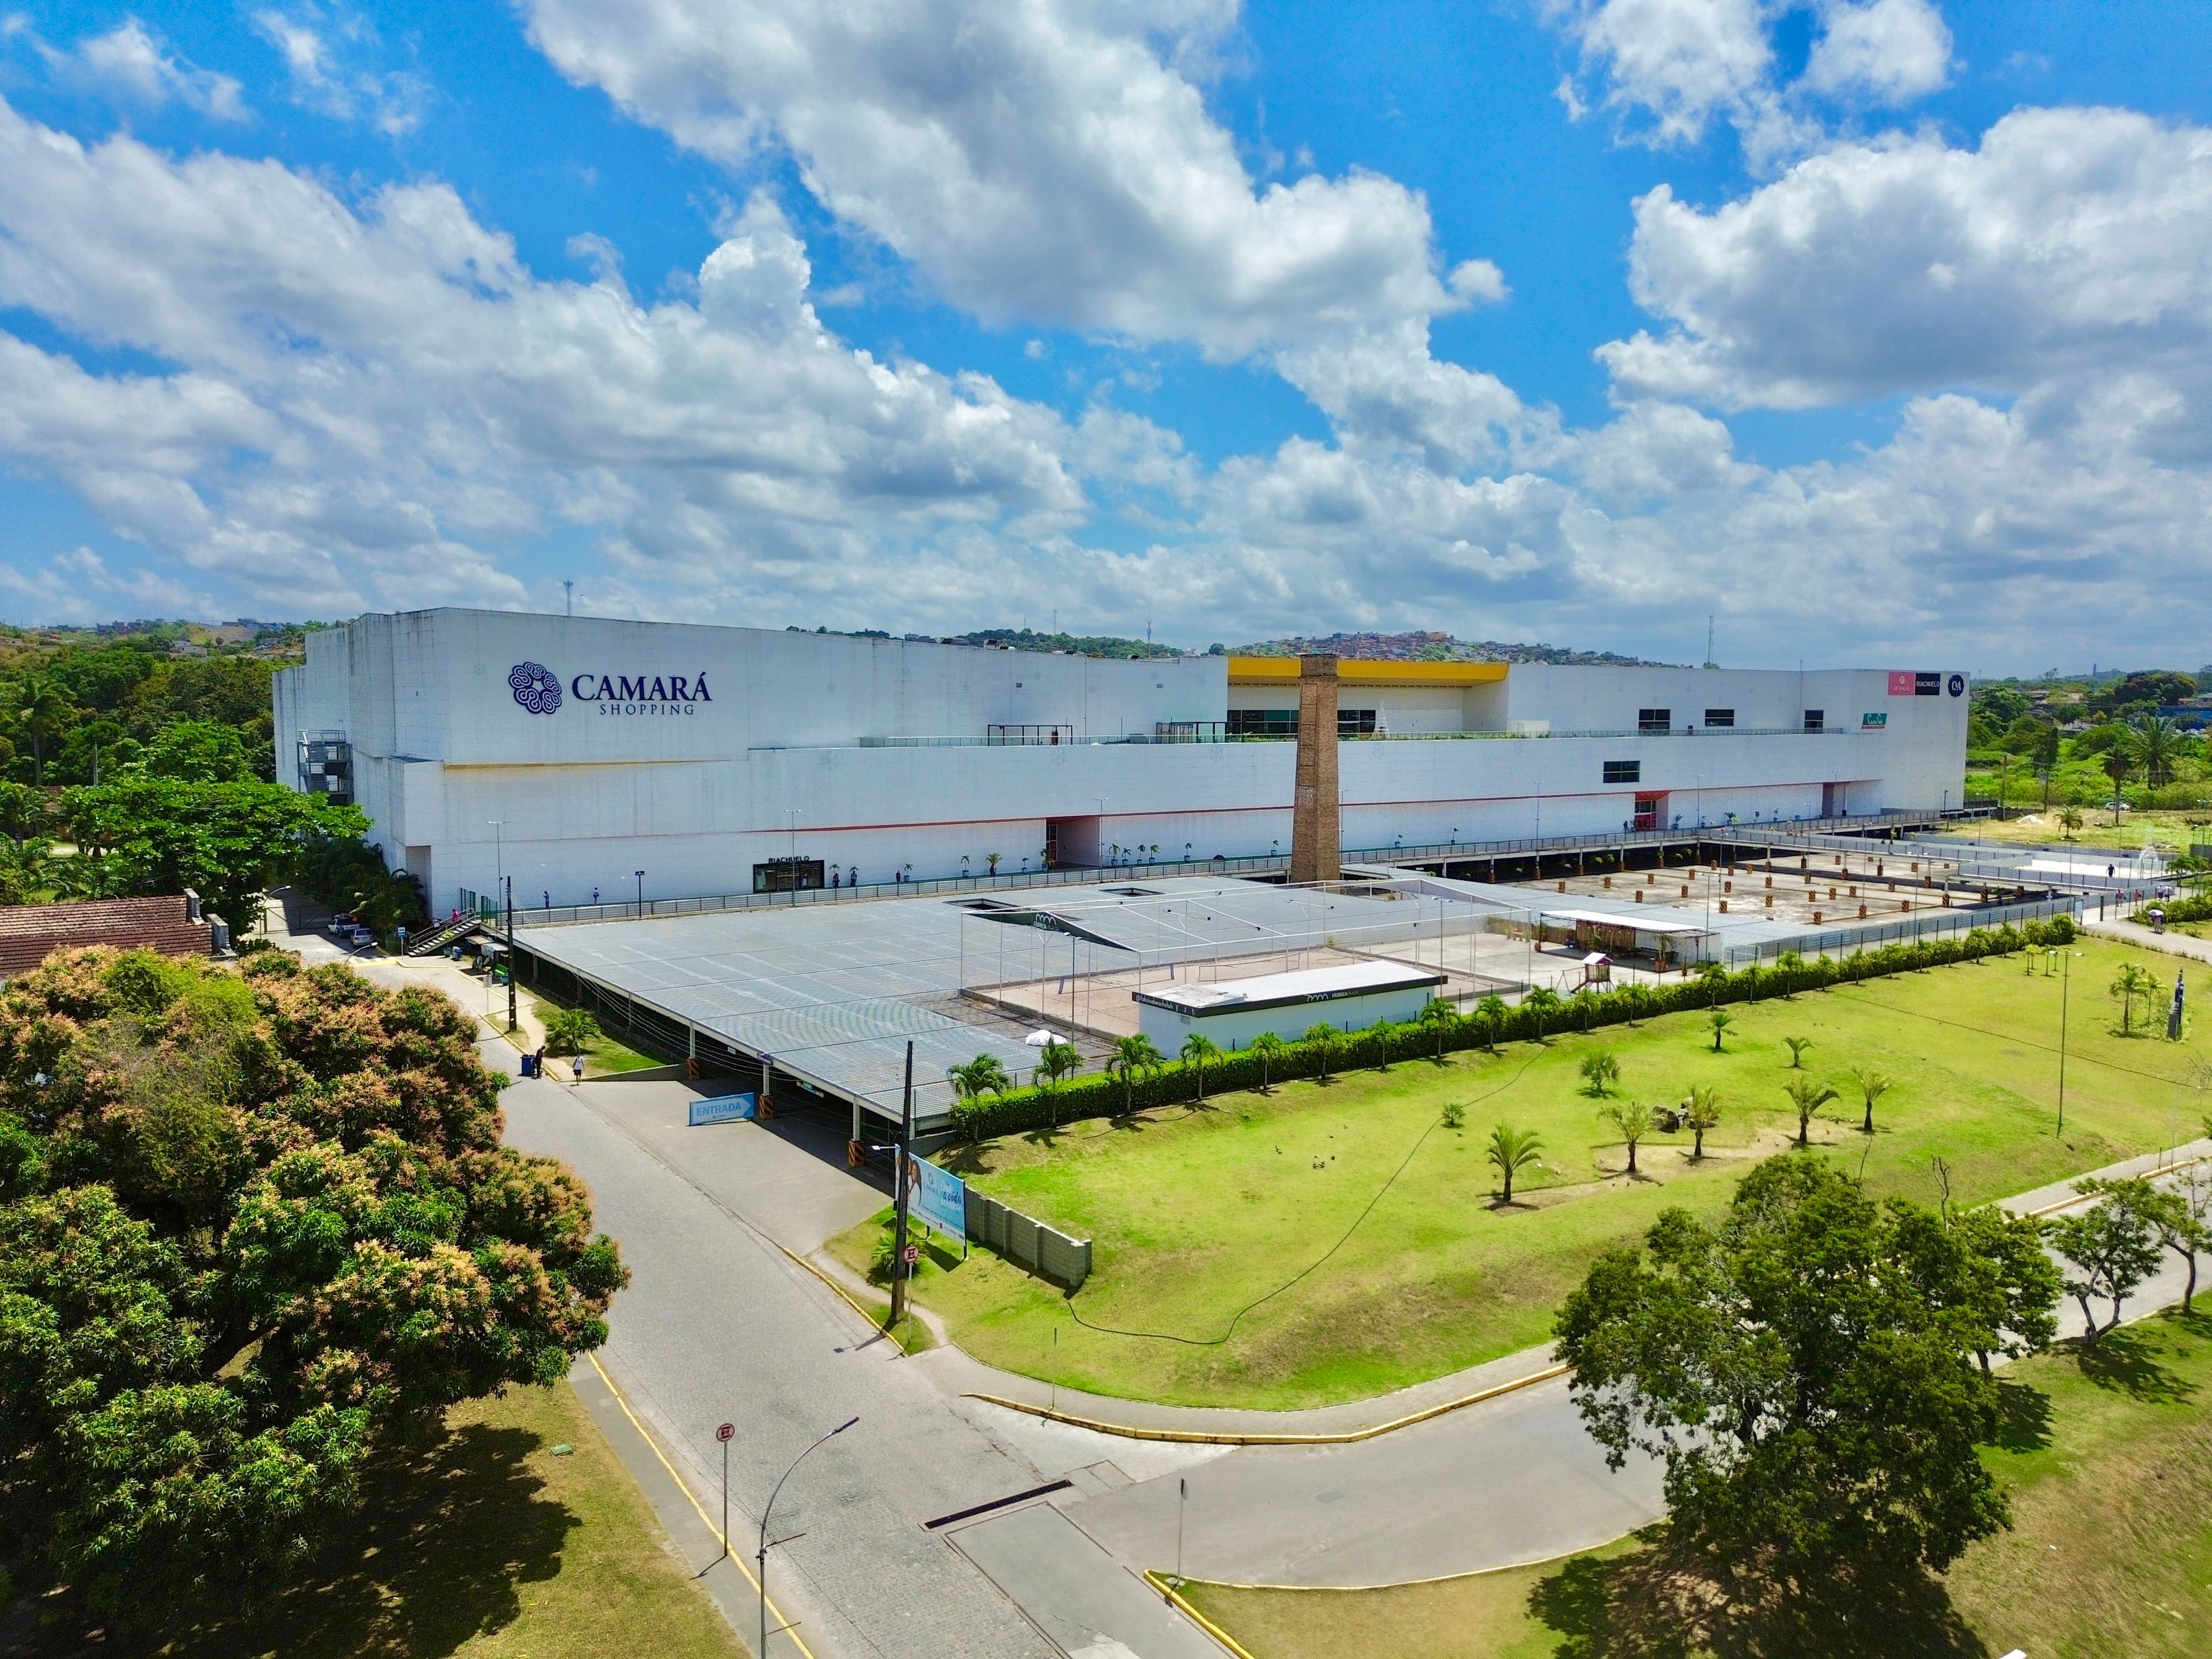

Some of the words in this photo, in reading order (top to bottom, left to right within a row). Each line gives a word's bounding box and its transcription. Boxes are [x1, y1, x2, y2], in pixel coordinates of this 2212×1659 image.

[572, 672, 713, 701] CAMARÁ
[600, 704, 694, 715] SHOPPING
[768, 856, 810, 864] RIACHUELO
[696, 1102, 741, 1116] ENTRADA
[948, 1191, 963, 1204] vida
